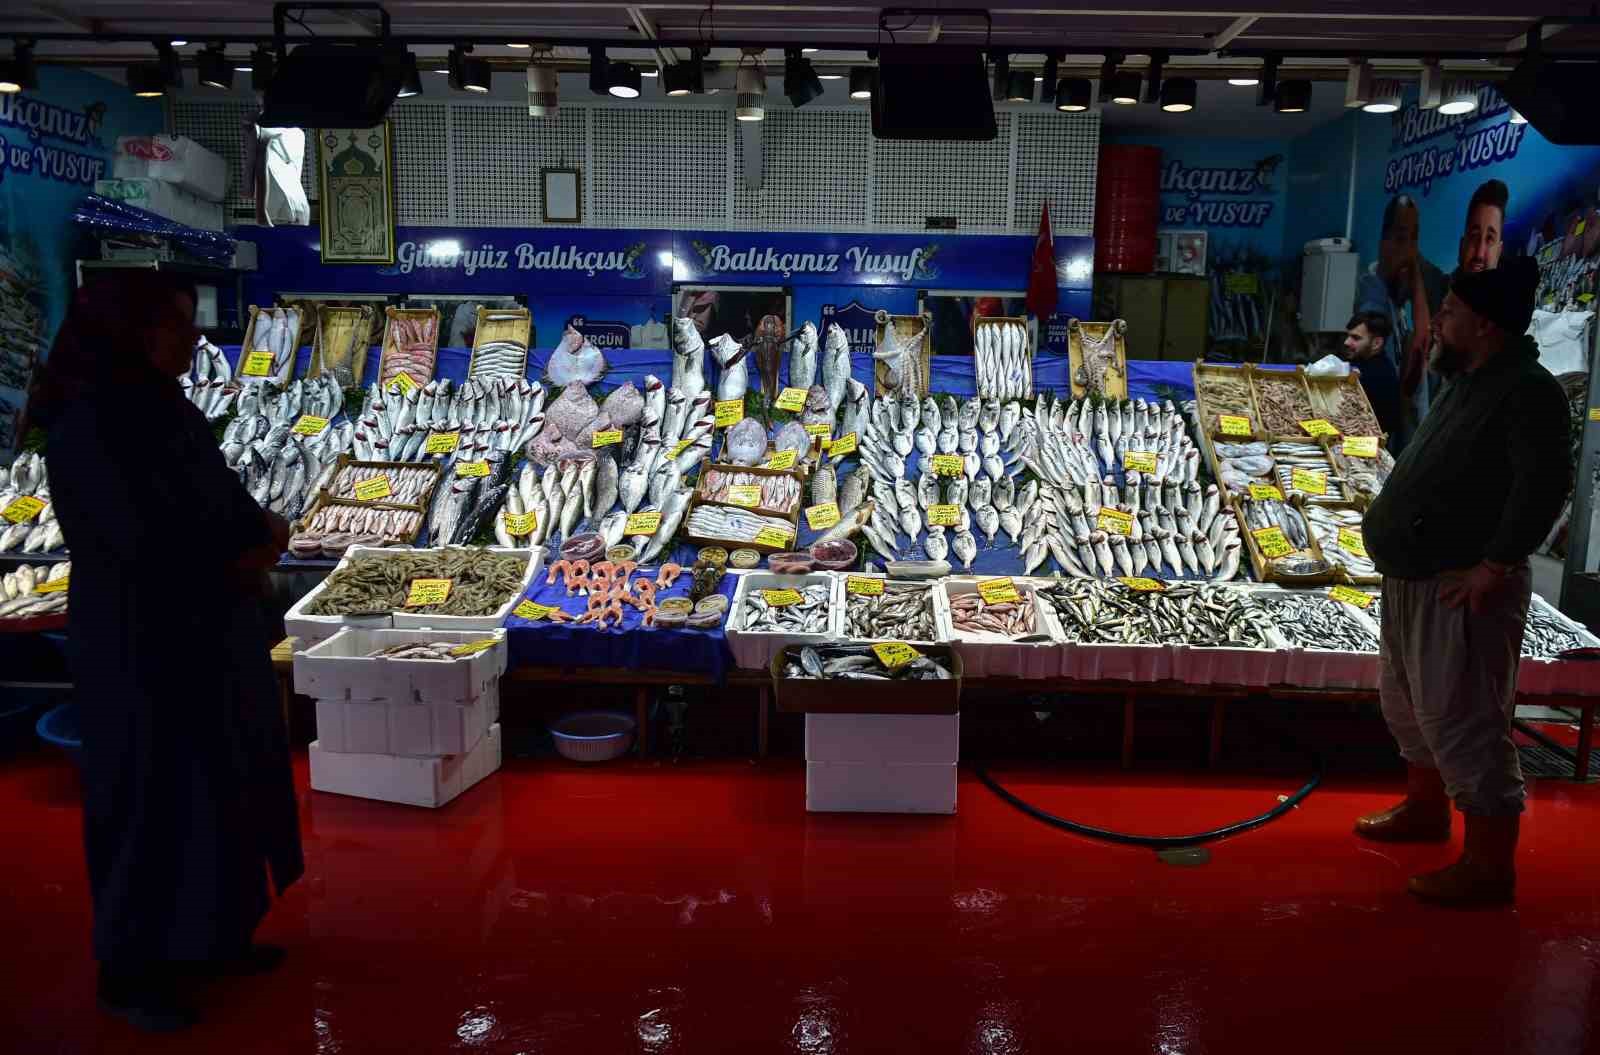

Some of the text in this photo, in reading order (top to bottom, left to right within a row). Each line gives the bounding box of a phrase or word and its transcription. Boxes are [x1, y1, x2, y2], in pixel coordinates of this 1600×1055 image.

[11, 147, 31, 169] ve
[34, 145, 104, 182] YUSUF
[1456, 123, 1524, 170] YUSUF
[1167, 201, 1271, 224] ve YUSUF
[515, 243, 625, 276] Balıkçısı
[711, 245, 922, 280] Balıkçınız Yusuf
